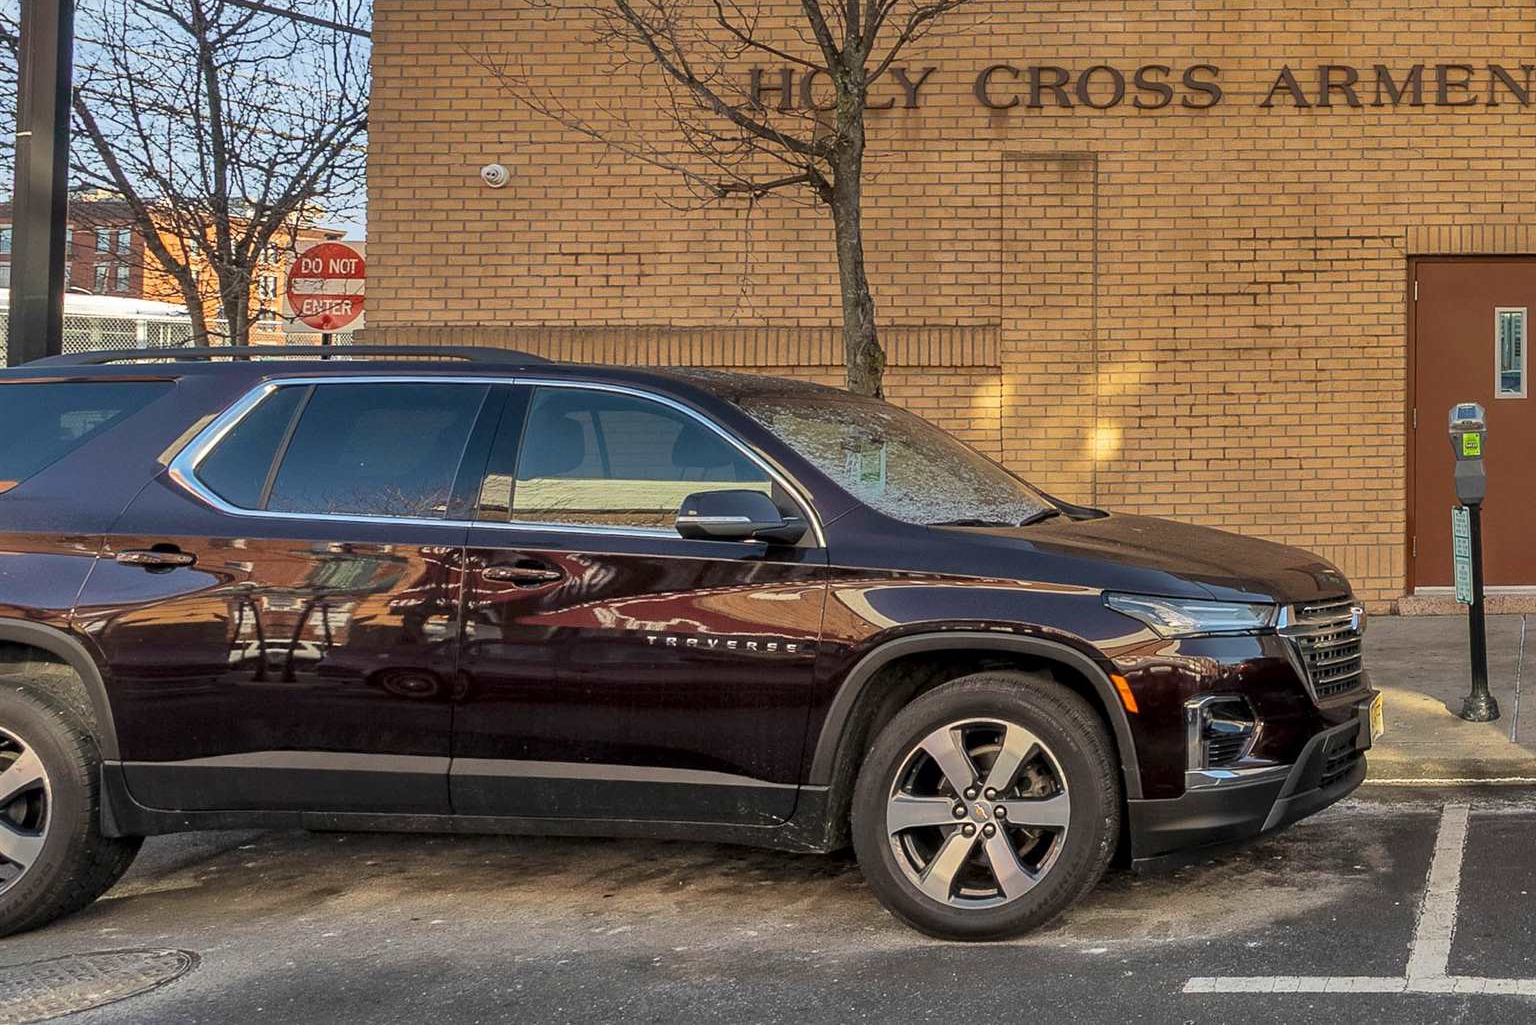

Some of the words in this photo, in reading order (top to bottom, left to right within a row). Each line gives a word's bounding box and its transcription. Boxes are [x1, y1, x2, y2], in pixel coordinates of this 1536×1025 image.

[974, 64, 1223, 111] CROSS
[301, 258, 323, 274] DO
[329, 258, 358, 274] NOT
[302, 299, 353, 315] ENTER
[647, 635, 798, 653] TRAVERSE
